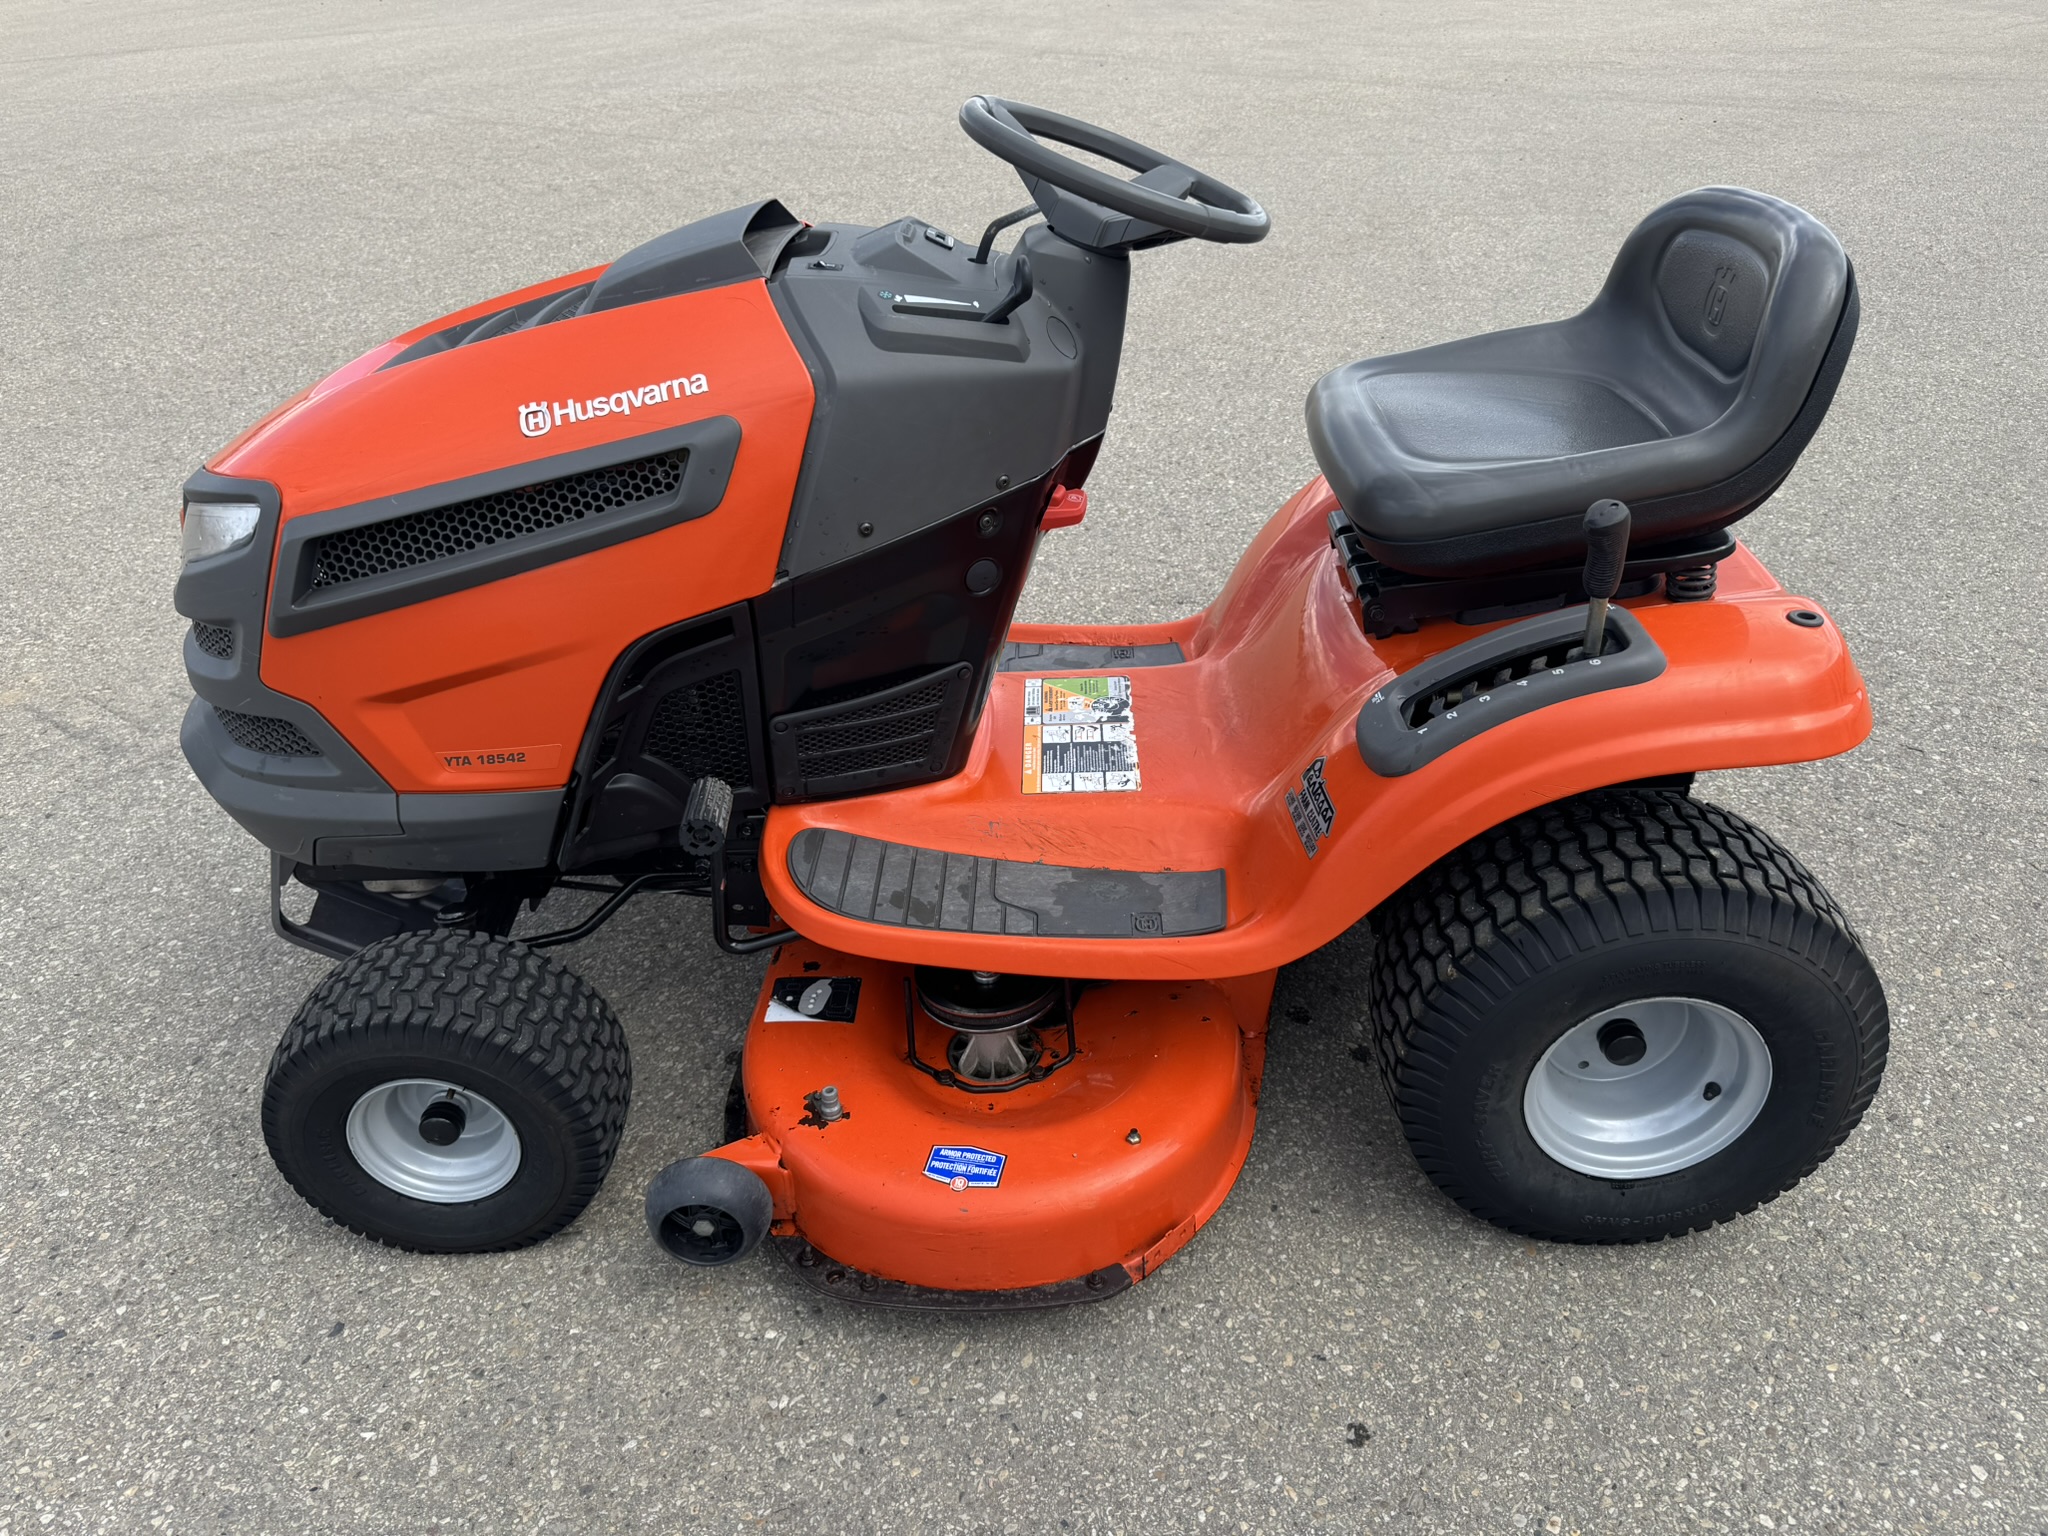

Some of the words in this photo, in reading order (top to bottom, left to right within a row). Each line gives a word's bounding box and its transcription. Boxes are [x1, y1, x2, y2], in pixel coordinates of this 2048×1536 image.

[553, 373, 709, 426] Husqvarna
[1479, 694, 1491, 703] 3
[1446, 711, 1458, 720] 2
[1417, 727, 1428, 735] 1
[444, 755, 473, 767] YTA
[476, 752, 526, 765] 18542
[1024, 743, 1033, 768] DANGER
[939, 1148, 961, 1158] ARMOR
[962, 1152, 997, 1162] PROTECTED
[930, 1160, 966, 1171] PROTECTION
[967, 1166, 998, 1177] FORTIFIÉE
[955, 1178, 964, 1187] 10
